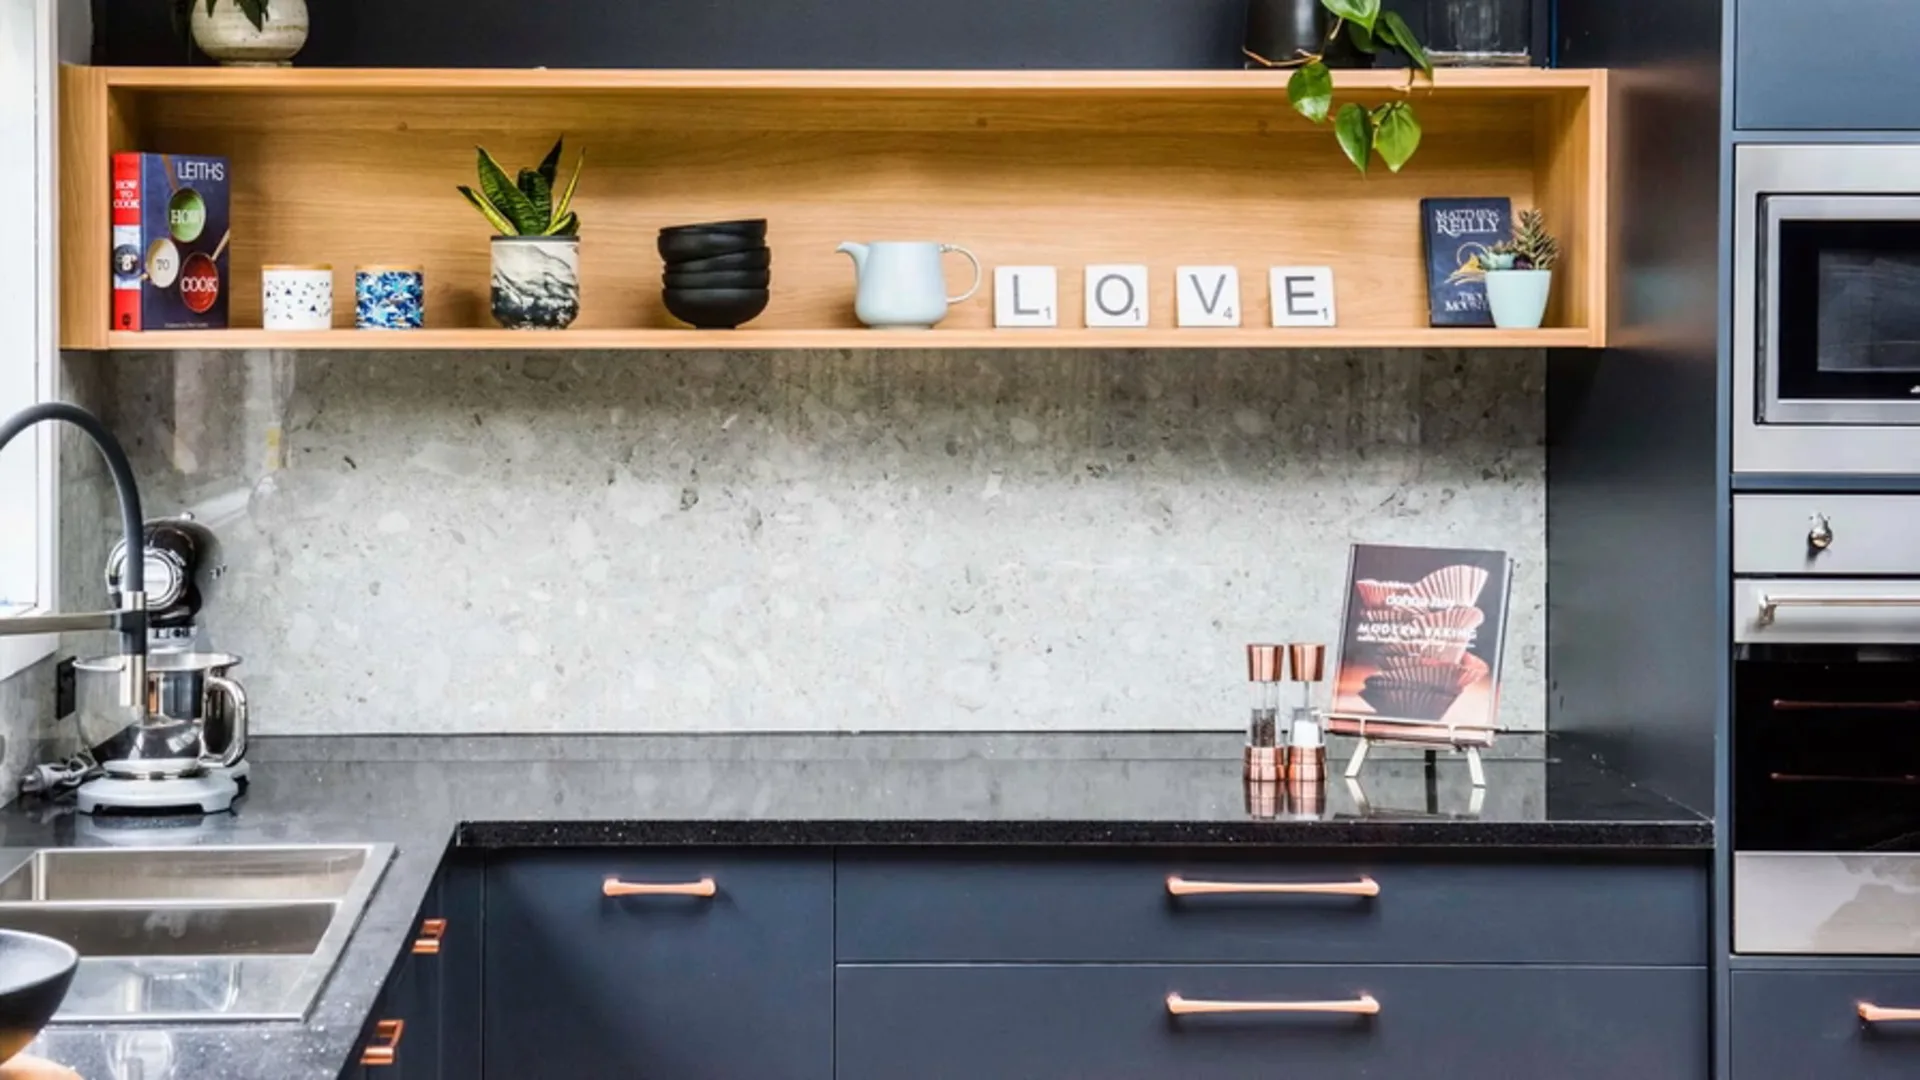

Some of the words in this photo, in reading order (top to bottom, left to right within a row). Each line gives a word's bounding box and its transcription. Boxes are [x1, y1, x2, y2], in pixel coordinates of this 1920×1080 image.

[177, 161, 224, 181] LEITHS
[115, 180, 137, 189] HOW
[113, 199, 140, 209] COOK
[170, 209, 204, 224] HOW
[1435, 208, 1500, 221] MATTHEW
[1436, 217, 1500, 238] REILLY
[156, 258, 170, 271] TO
[181, 276, 217, 292] COOK
[1356, 623, 1419, 637] MODERN
[1424, 627, 1477, 640] BAKING
